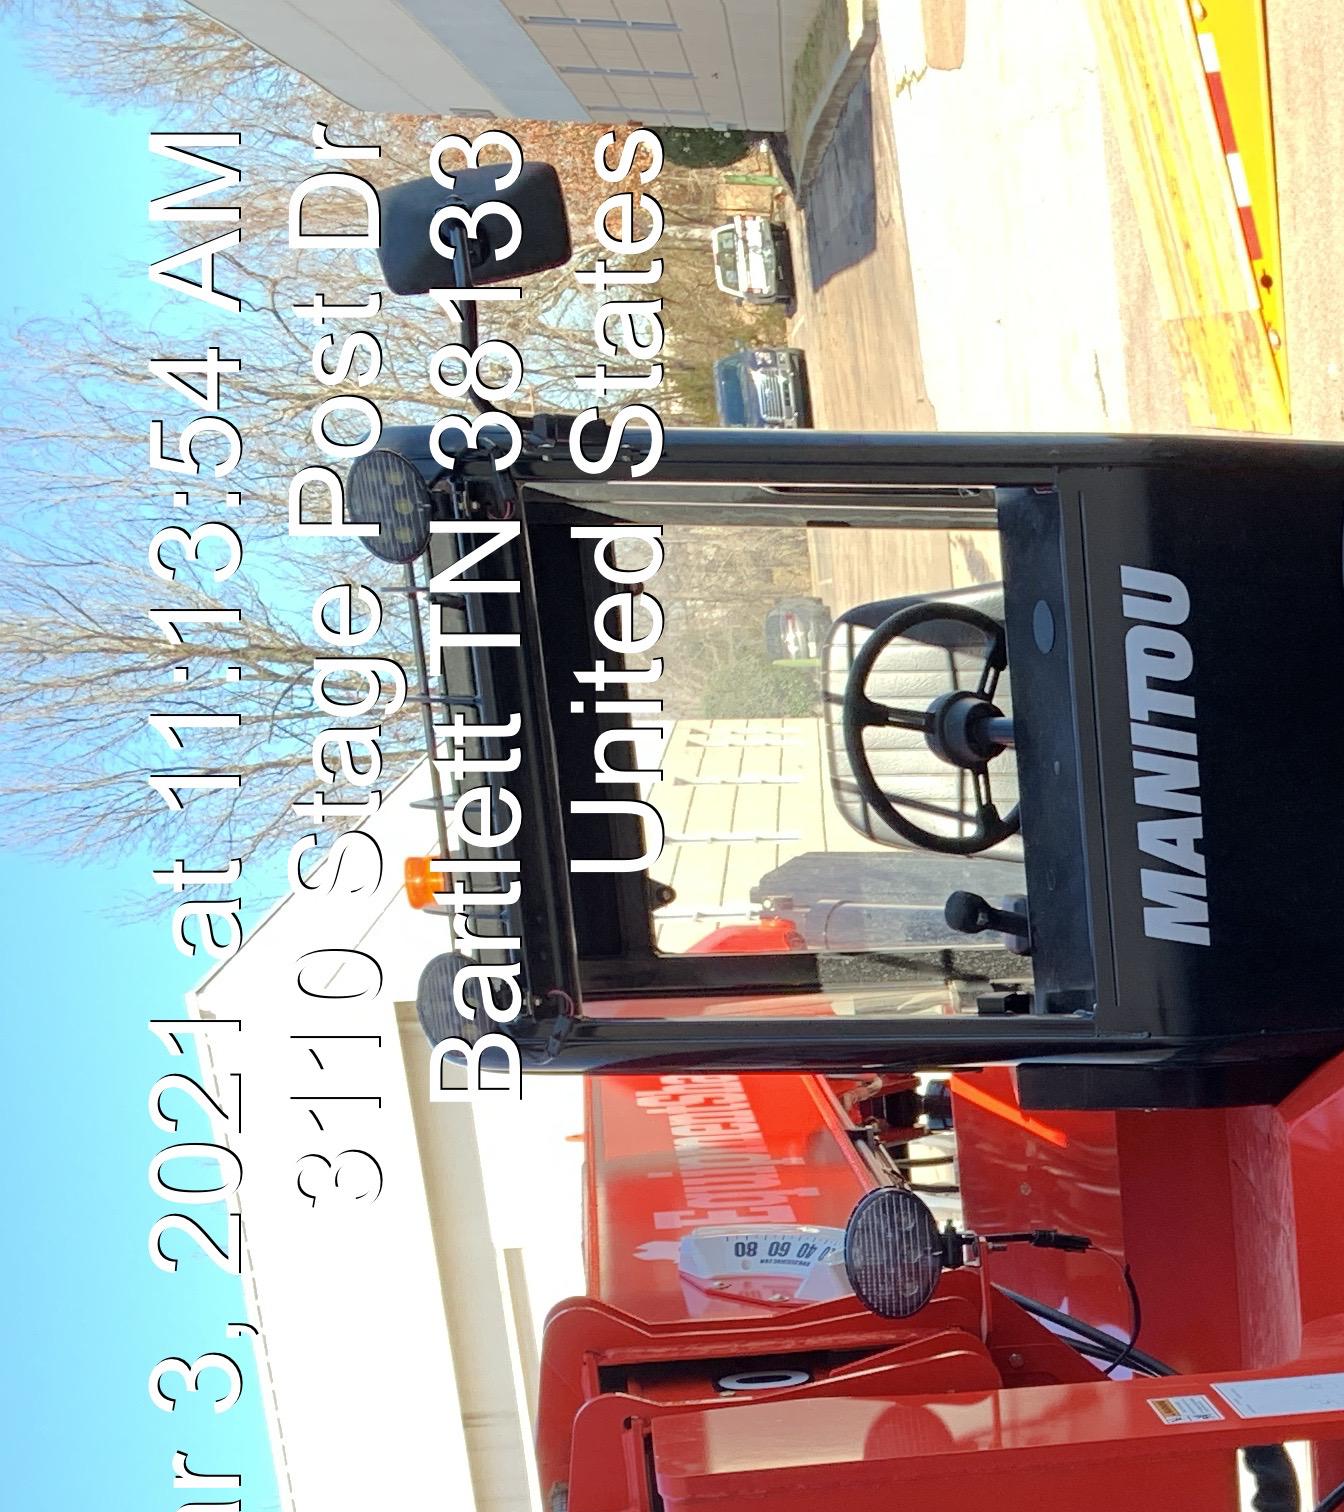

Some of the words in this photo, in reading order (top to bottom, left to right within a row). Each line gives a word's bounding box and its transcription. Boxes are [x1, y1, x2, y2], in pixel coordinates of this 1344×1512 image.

[1120, 565, 1211, 946] MANITOU
[634, 1074, 820, 1229] EquipmentSha
[734, 1241, 758, 1257] 80
[767, 1241, 791, 1256] 60
[798, 1242, 818, 1259] 40
